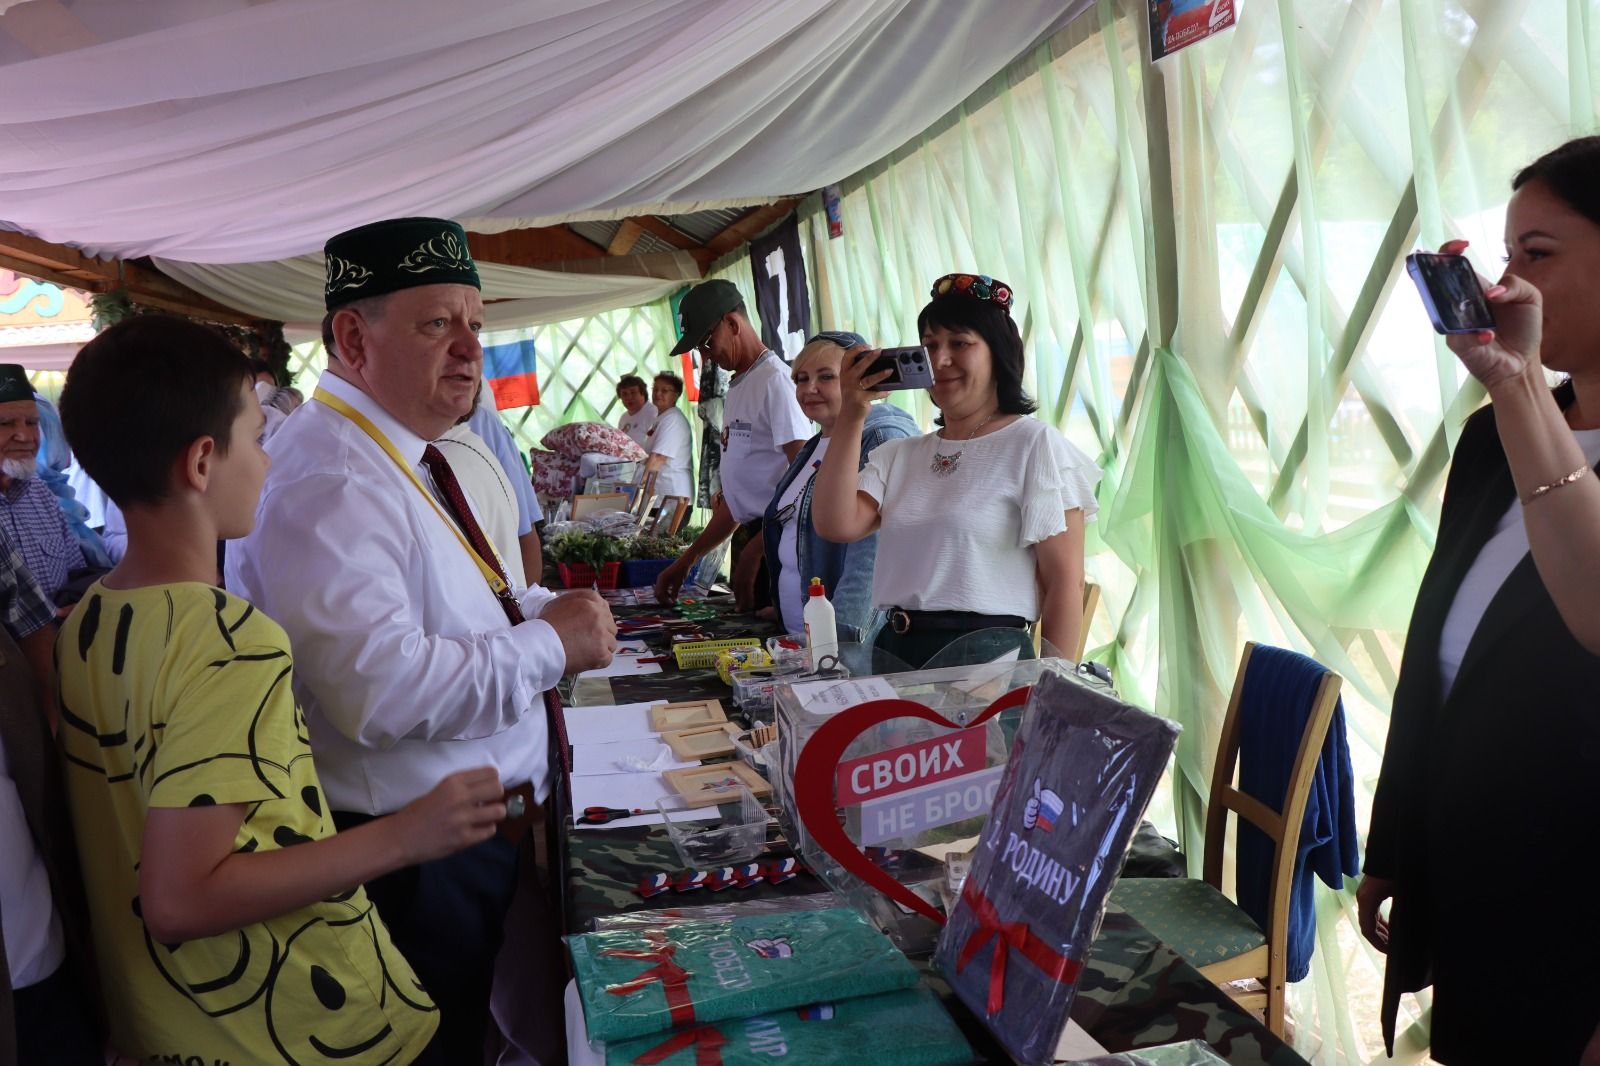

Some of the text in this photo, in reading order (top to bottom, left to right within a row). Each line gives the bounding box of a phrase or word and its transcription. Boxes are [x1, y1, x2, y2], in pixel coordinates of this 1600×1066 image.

[851, 738, 965, 795] СВОИХ
[877, 802, 916, 836] НЕ
[1000, 831, 1081, 905] РОДИНУ
